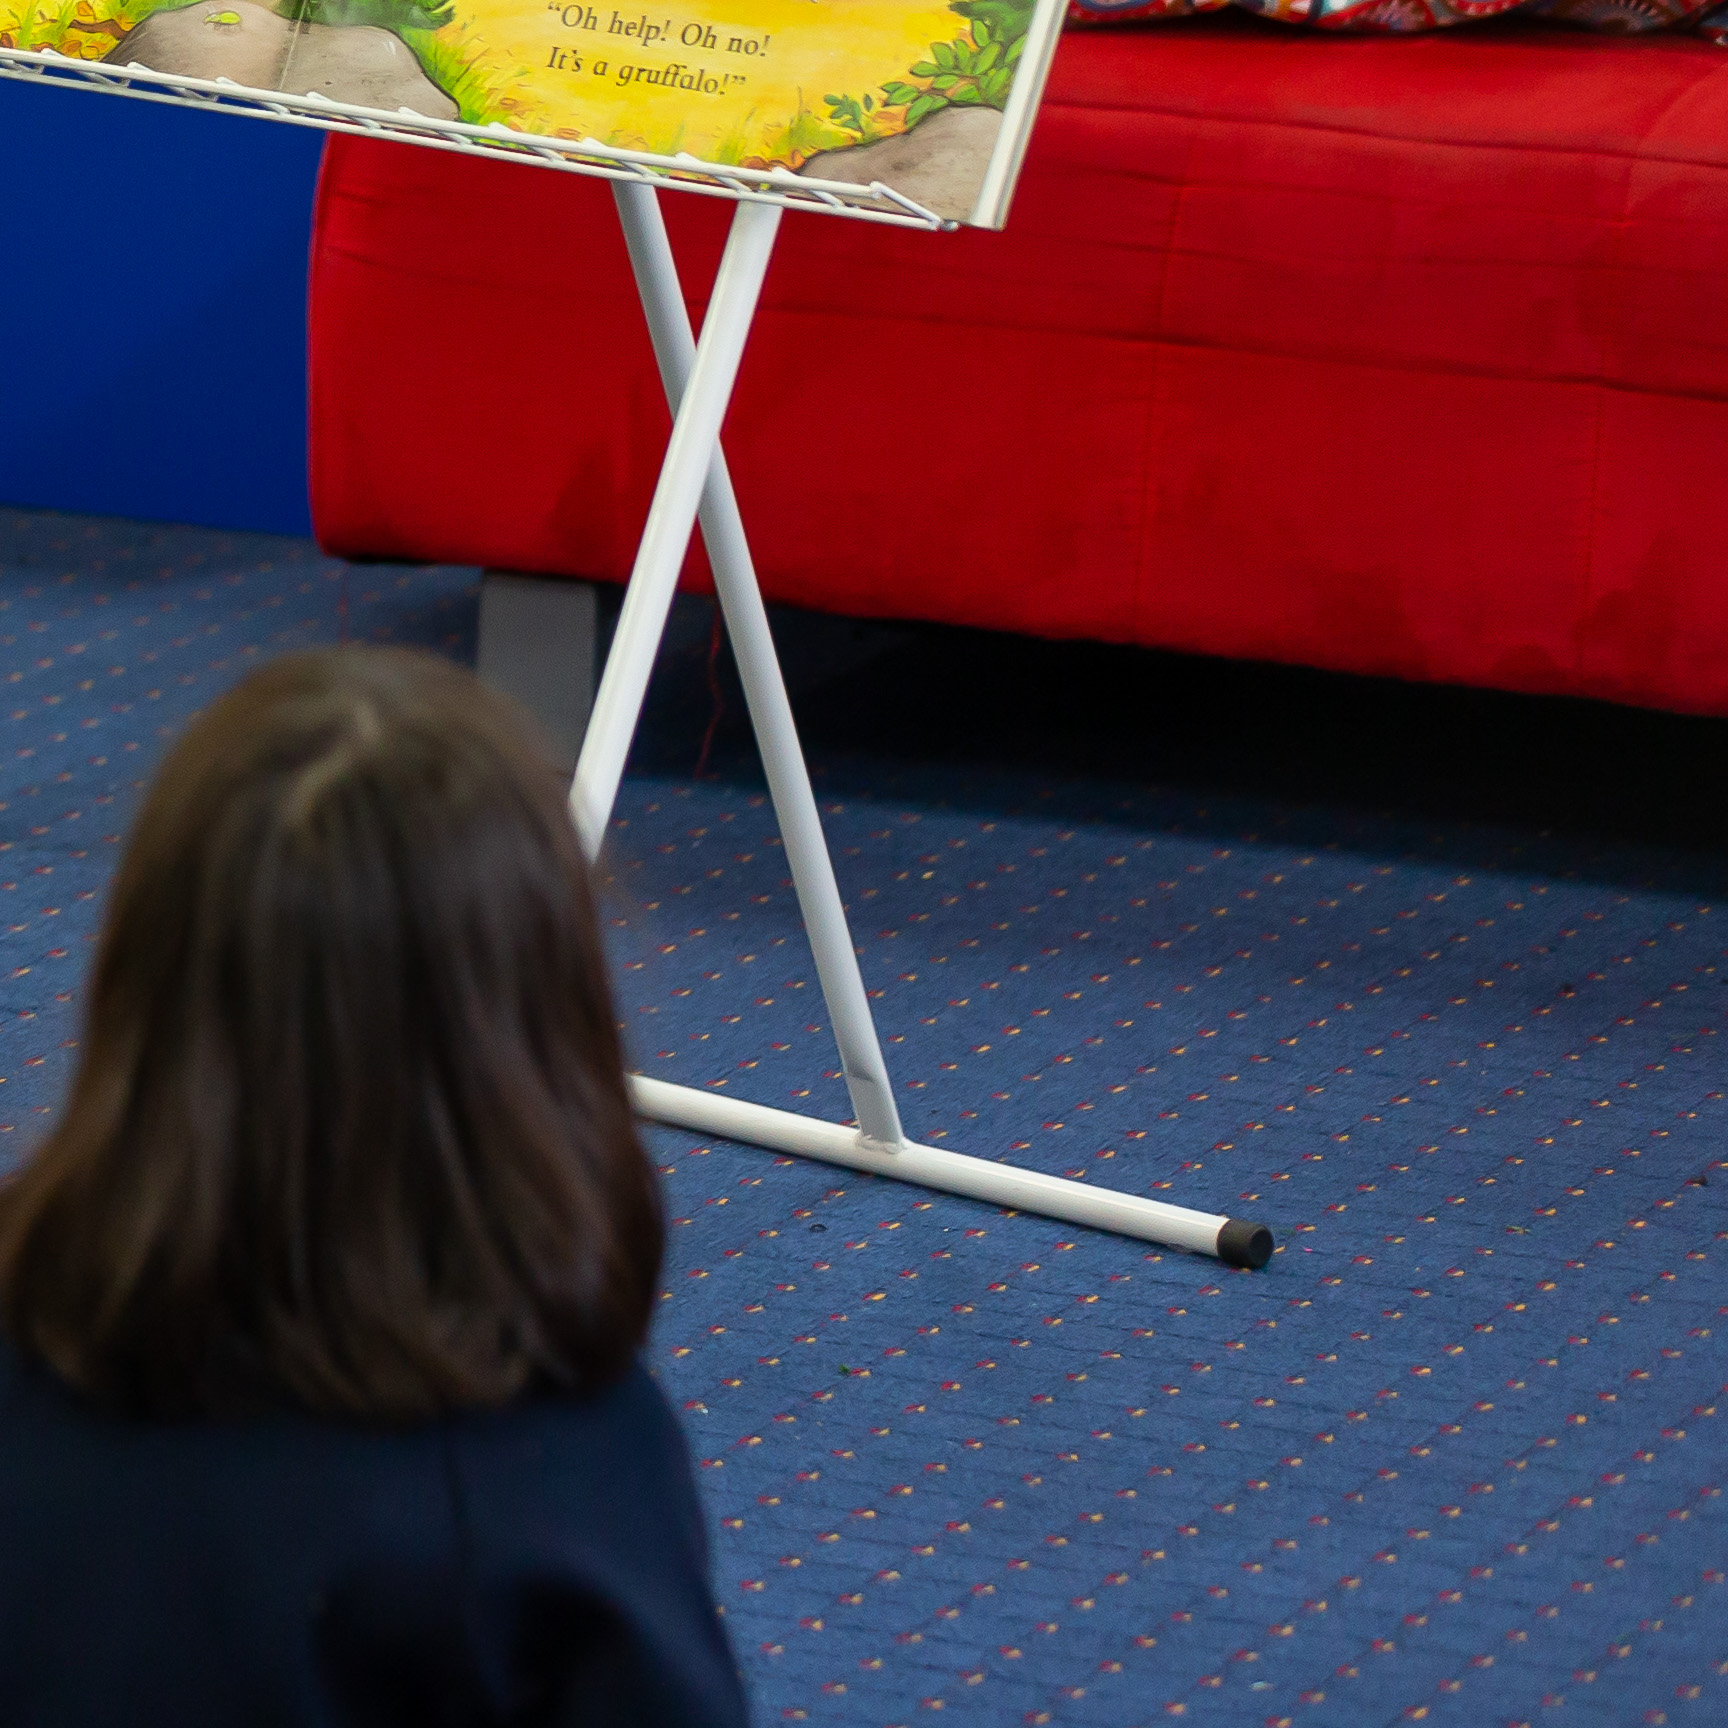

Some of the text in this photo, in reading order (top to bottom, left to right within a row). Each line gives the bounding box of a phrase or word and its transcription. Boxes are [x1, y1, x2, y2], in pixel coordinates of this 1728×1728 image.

[547, 0, 771, 58] “Oh help! Oh no!
[545, 45, 747, 96] It’s a gruffalo!”
